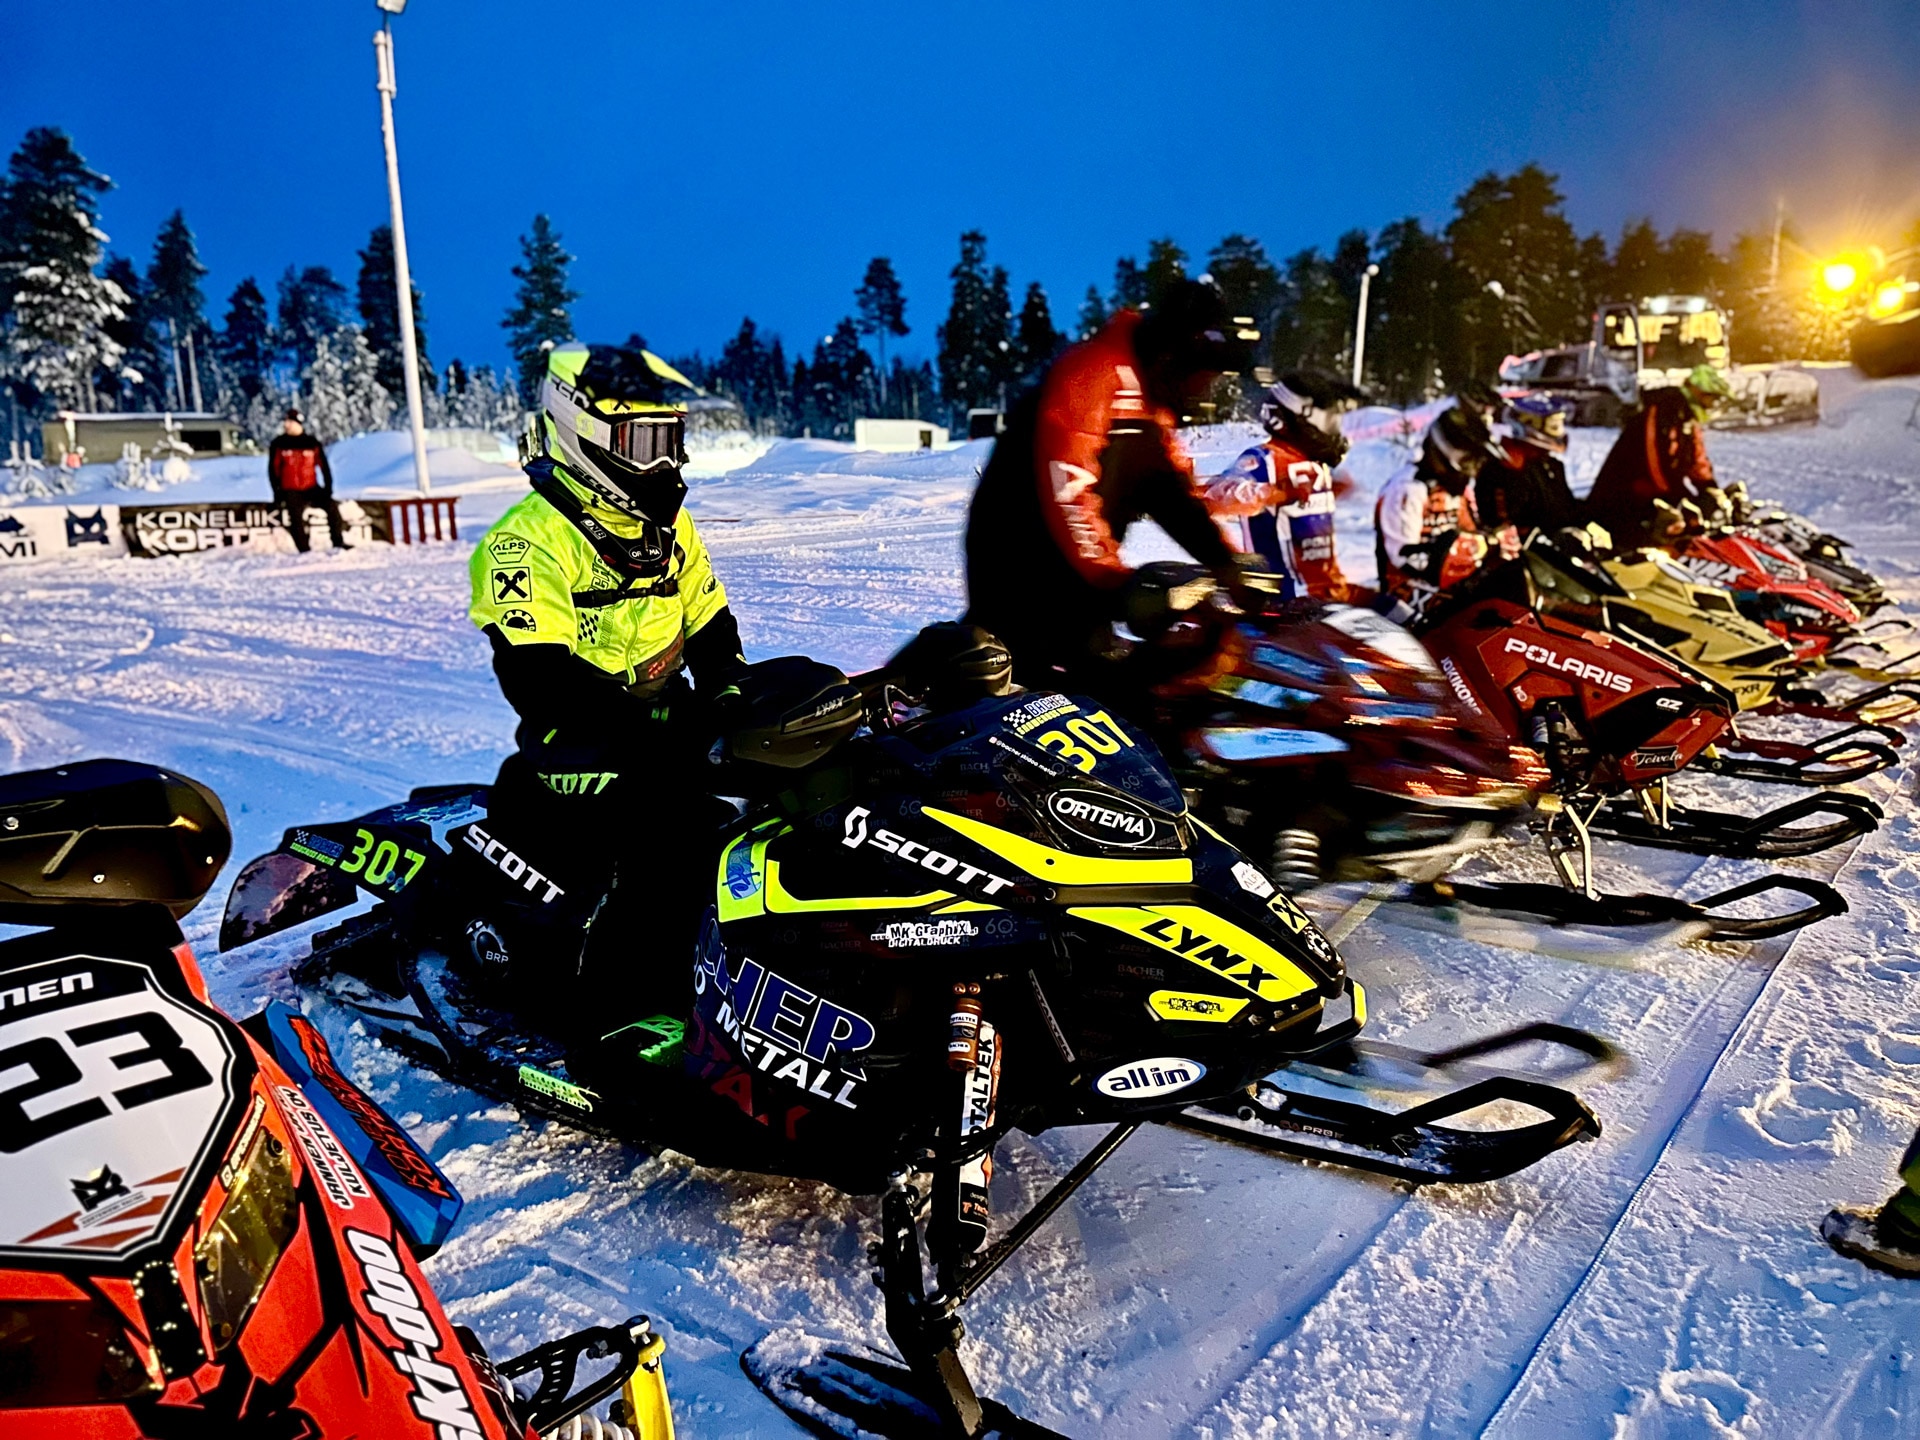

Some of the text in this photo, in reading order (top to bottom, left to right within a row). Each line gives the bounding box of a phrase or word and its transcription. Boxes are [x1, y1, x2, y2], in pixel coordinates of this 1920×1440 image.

[631, 547, 661, 558] ORMA
[1504, 637, 1634, 694] POLARIS
[1037, 709, 1135, 775] 307
[538, 772, 619, 795] SCOTT
[1055, 796, 1146, 838] ORTEMA
[339, 828, 427, 893] 307
[463, 824, 565, 904] SCOTT
[868, 828, 1015, 896] SCOTT
[485, 950, 509, 964] BRP
[1139, 918, 1280, 993] LYNX
[0, 1011, 214, 1155] 23
[300, 1110, 367, 1195] KULJETUS
[300, 1135, 352, 1207] JANNEN
